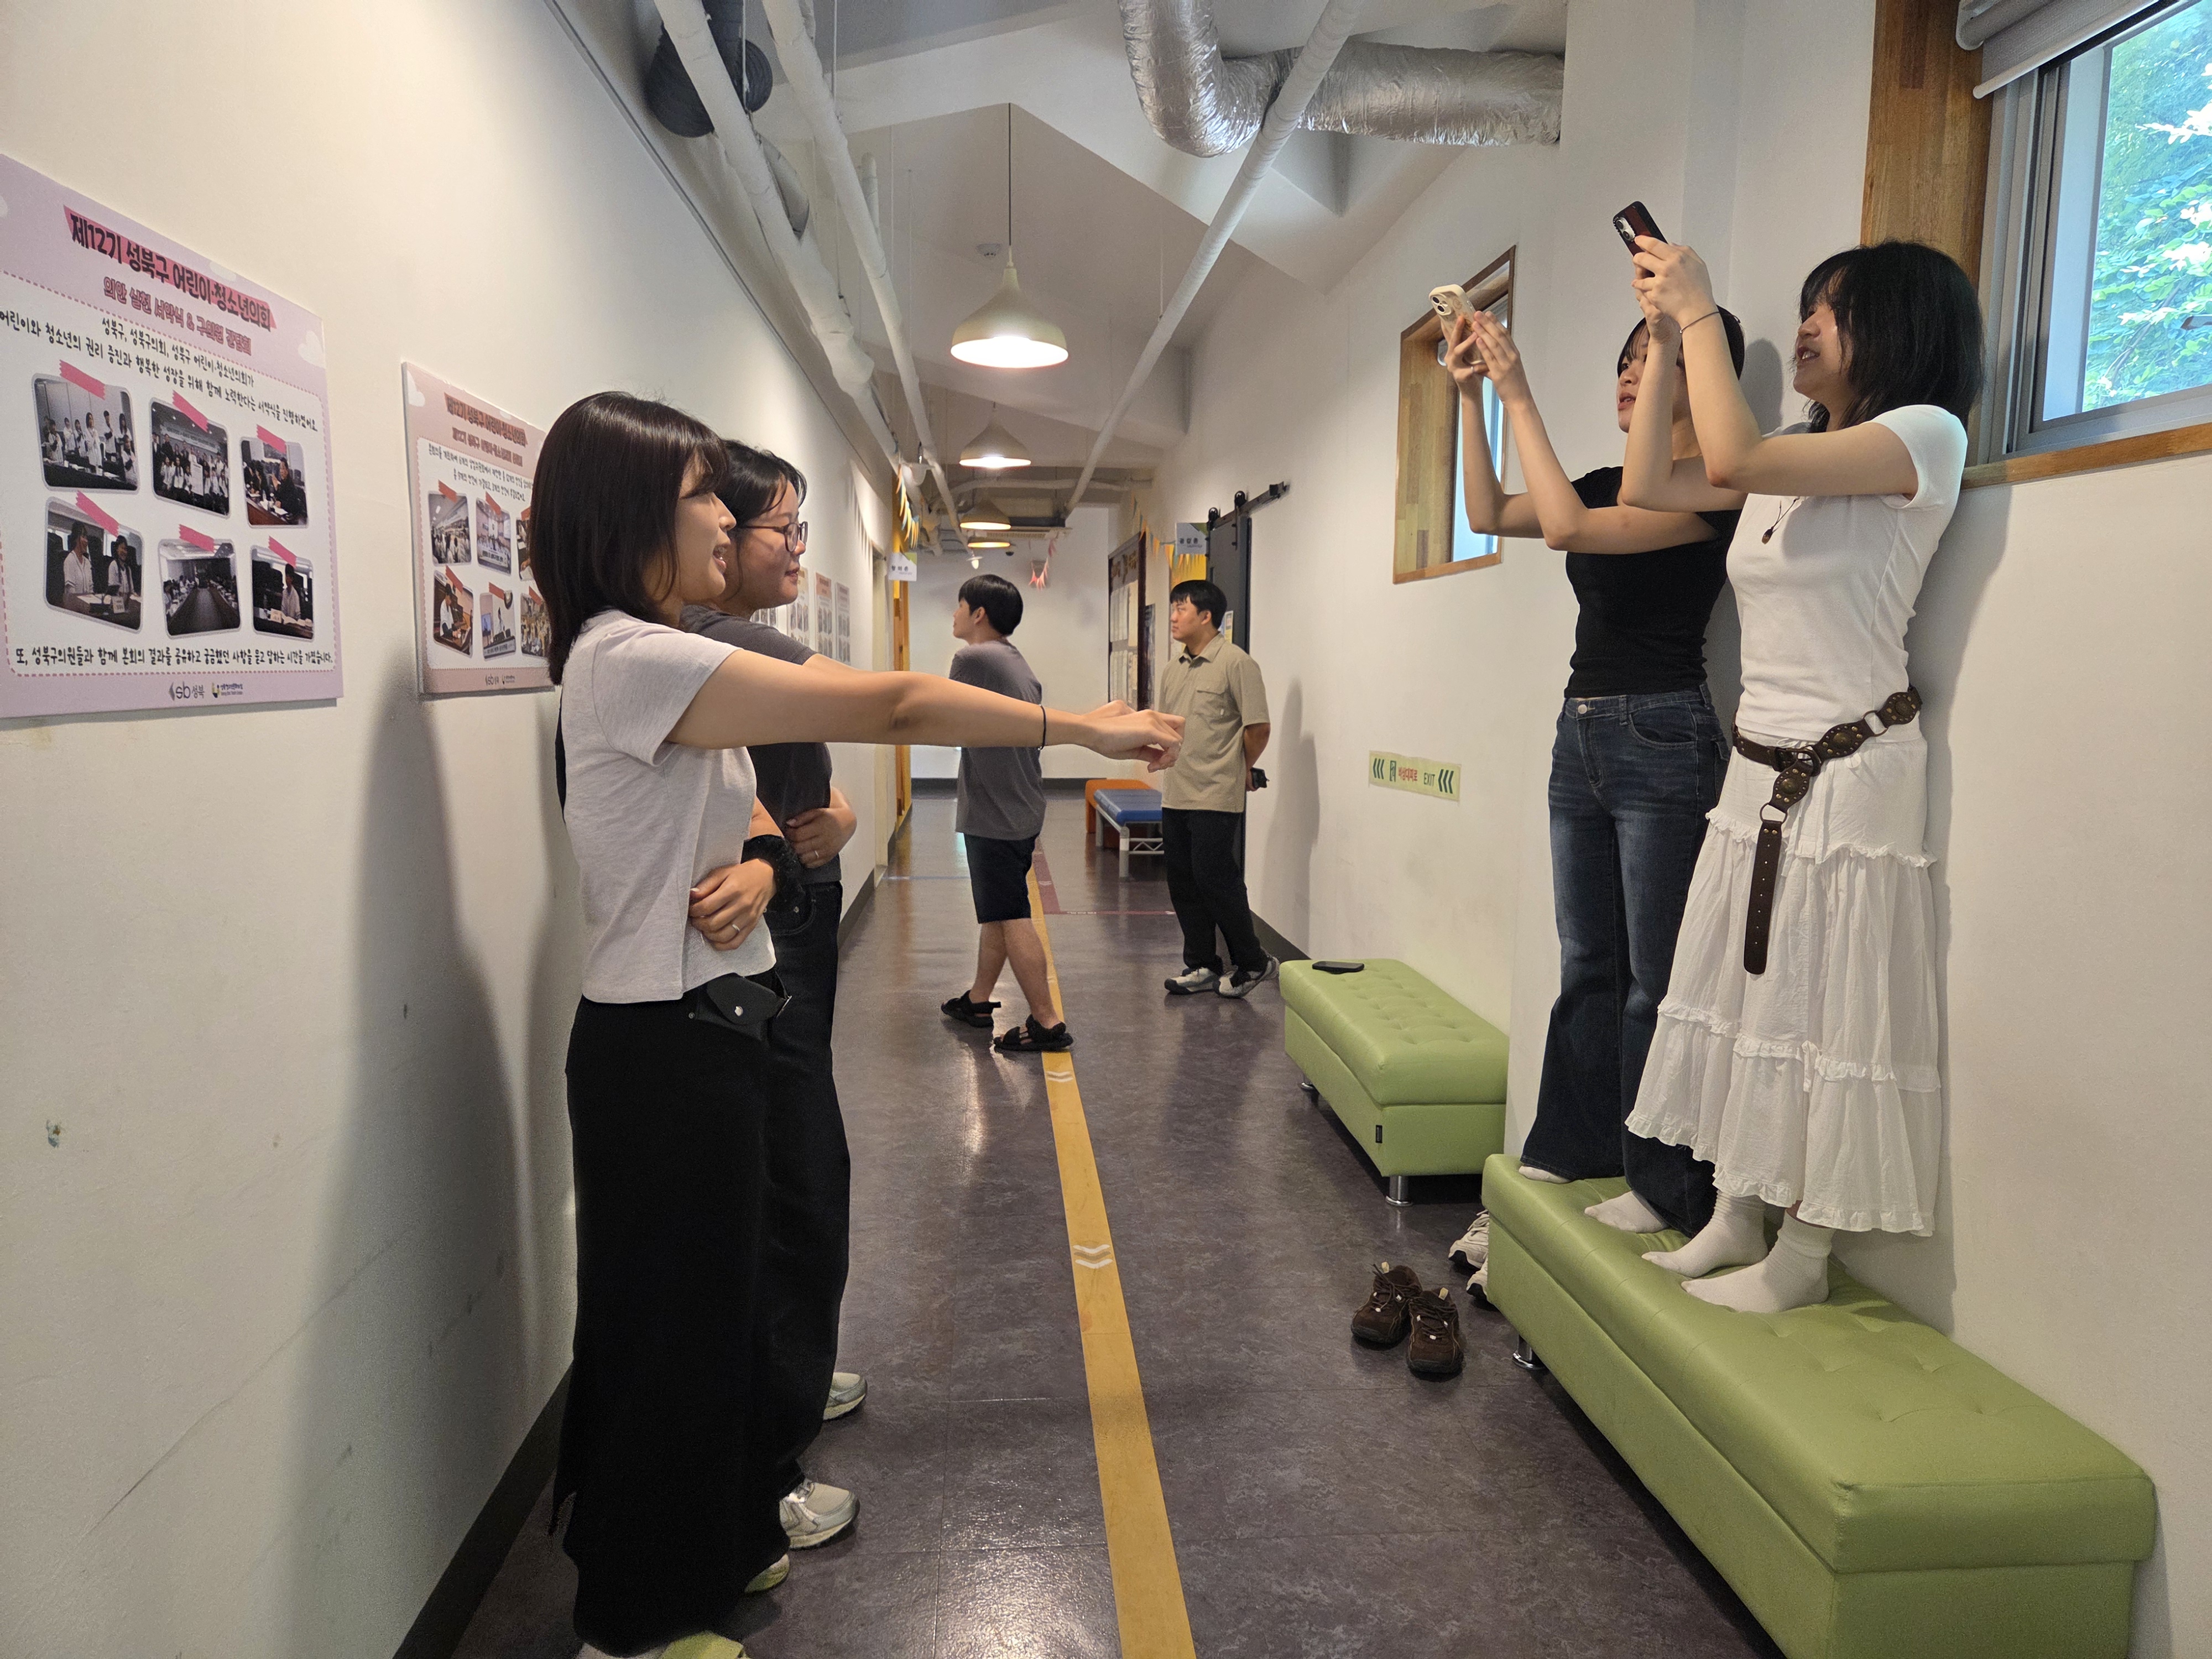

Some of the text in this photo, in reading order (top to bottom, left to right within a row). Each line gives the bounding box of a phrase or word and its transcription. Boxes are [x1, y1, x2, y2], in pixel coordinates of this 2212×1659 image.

[70, 213, 122, 264] 제12기
[127, 240, 169, 283] 성북구
[103, 276, 127, 304] 의안
[129, 287, 152, 315] 실천
[154, 298, 184, 328] 서약식
[186, 312, 195, 332] &
[196, 315, 223, 345] 구의원
[0, 310, 41, 337] 어린이와
[45, 322, 81, 351] 청소년의
[86, 337, 103, 359] 권리
[107, 345, 132, 368] 증진과
[135, 354, 160, 379] 행복한
[163, 366, 184, 388] 성장을
[187, 375, 203, 392] 위해
[206, 380, 222, 399] 함께
[225, 388, 255, 411] 노력한다는
[102, 317, 127, 342] 성북구,
[130, 328, 169, 358] 성북구의회,
[172, 344, 191, 364] 성북구
[16, 648, 28, 666] 또,
[32, 645, 94, 666] 성북구의원들과
[97, 647, 118, 665] 함께
[122, 647, 145, 665] 본회의
[148, 646, 172, 666] 결과를
[175, 648, 201, 665] 공유하고
[204, 648, 229, 665] 궁금했던
[233, 649, 252, 665] 사항을
[267, 649, 285, 665] 답하는
[287, 649, 304, 665] 시간을
[1423, 773, 1436, 786] EXIT
